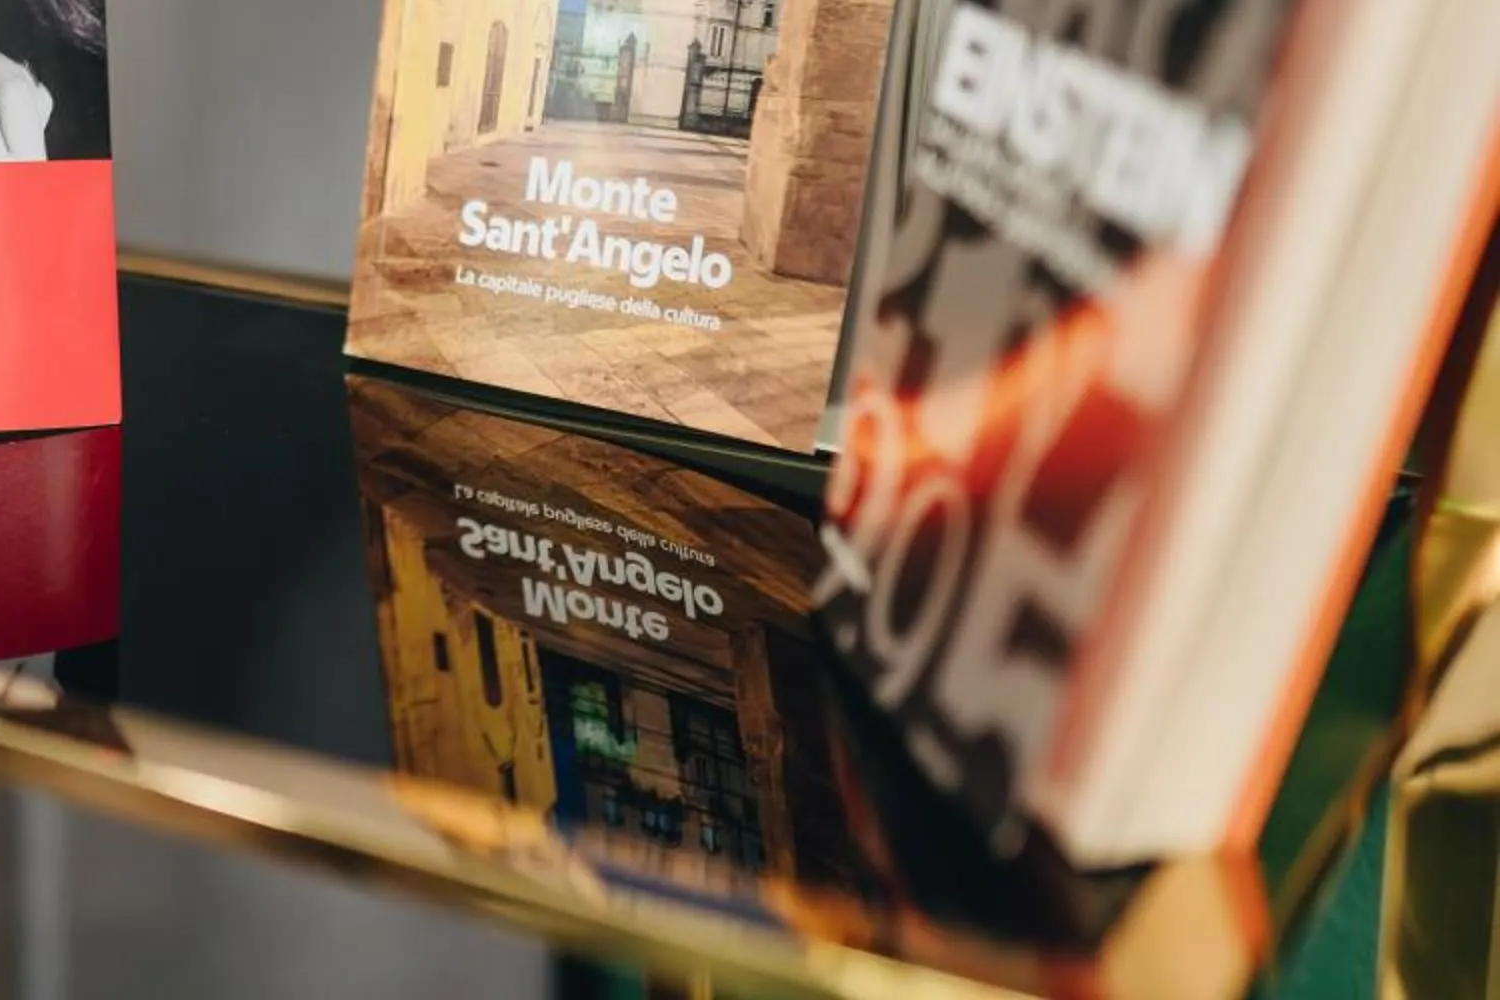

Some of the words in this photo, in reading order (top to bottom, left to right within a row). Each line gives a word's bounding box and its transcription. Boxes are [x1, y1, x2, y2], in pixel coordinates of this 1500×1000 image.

[526, 156, 678, 223] Monte
[459, 200, 732, 289] Sant'Angelo
[455, 265, 475, 287] La
[478, 273, 543, 298] capitale
[545, 286, 617, 311] pugliese
[620, 296, 660, 322] della
[664, 307, 722, 331] cultura
